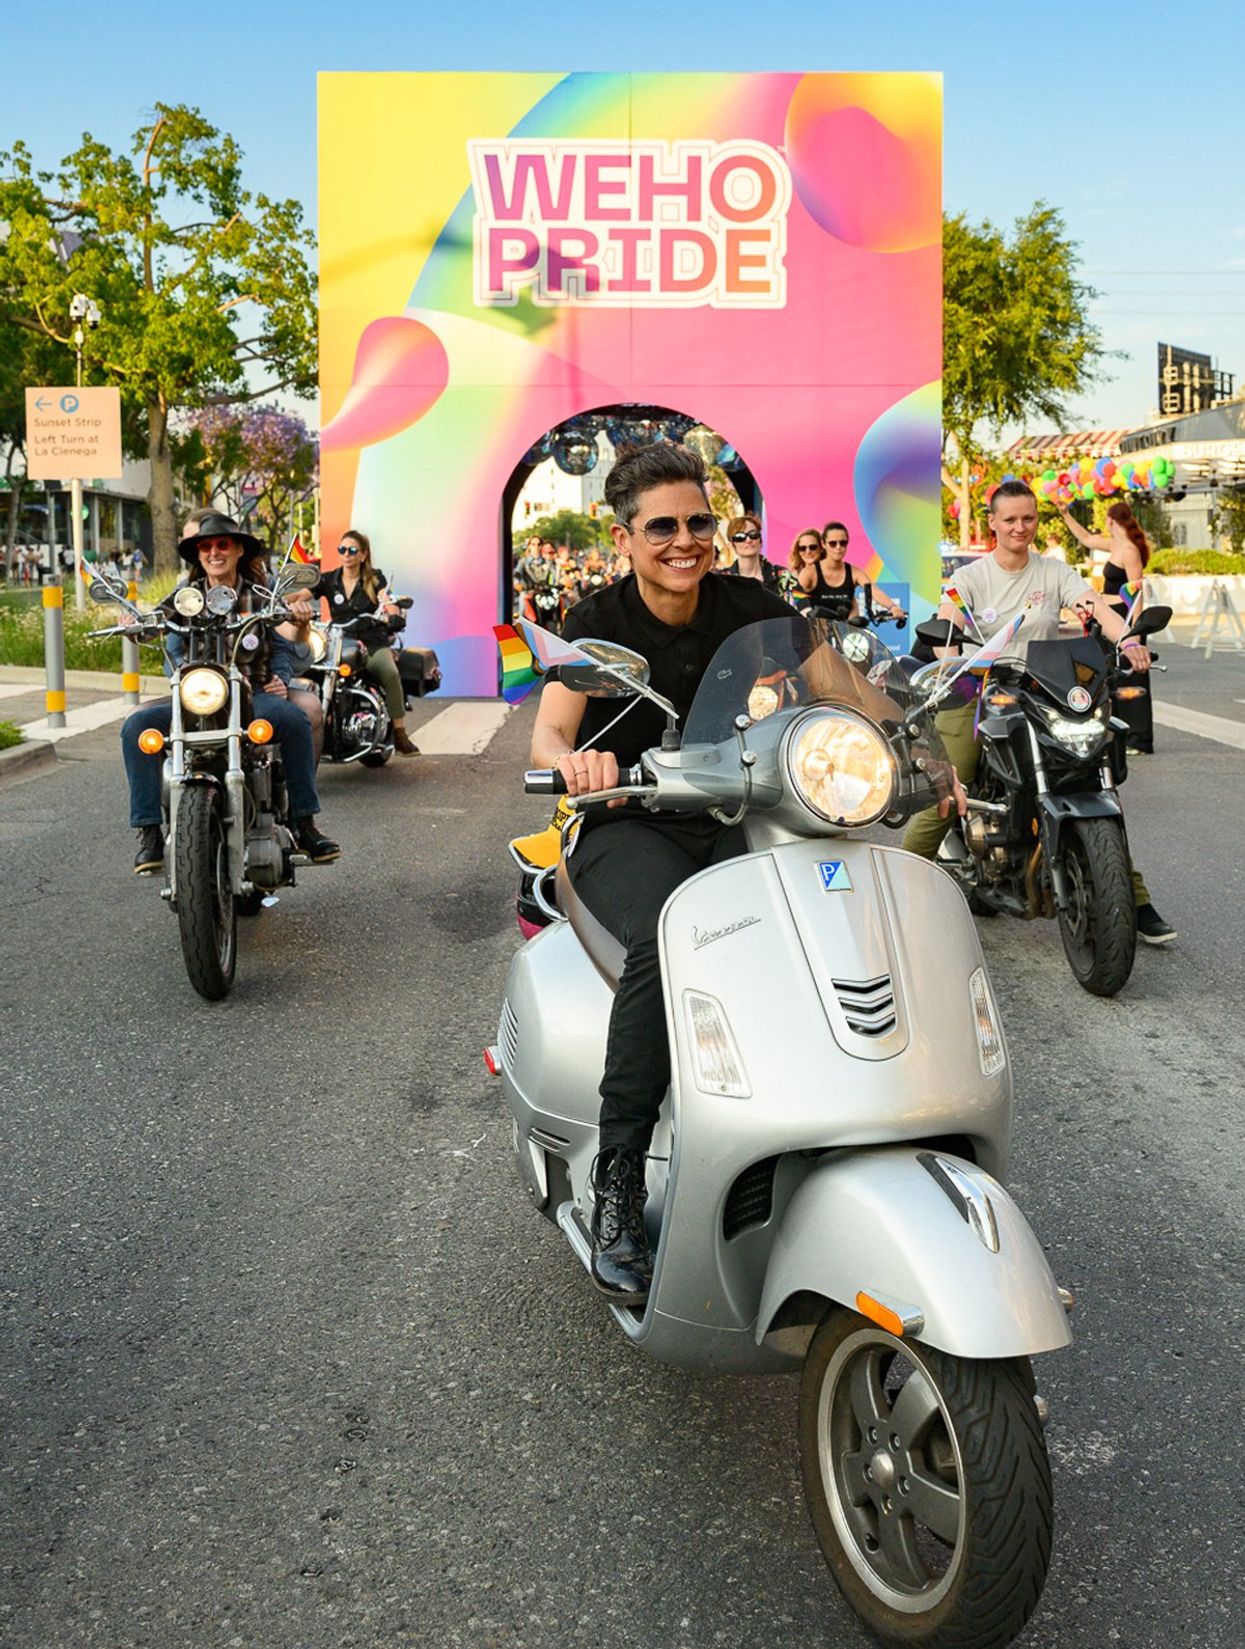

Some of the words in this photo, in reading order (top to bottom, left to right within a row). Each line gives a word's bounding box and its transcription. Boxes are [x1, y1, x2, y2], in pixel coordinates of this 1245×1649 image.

[484, 154, 777, 223] WEHO
[488, 227, 772, 293] PRIDE
[34, 418, 71, 427] Sunset
[75, 418, 101, 427] Strip
[34, 435, 56, 444] Left
[61, 435, 85, 444] Turn
[88, 435, 99, 444] at
[35, 447, 48, 456] La
[51, 447, 97, 456] Cienega
